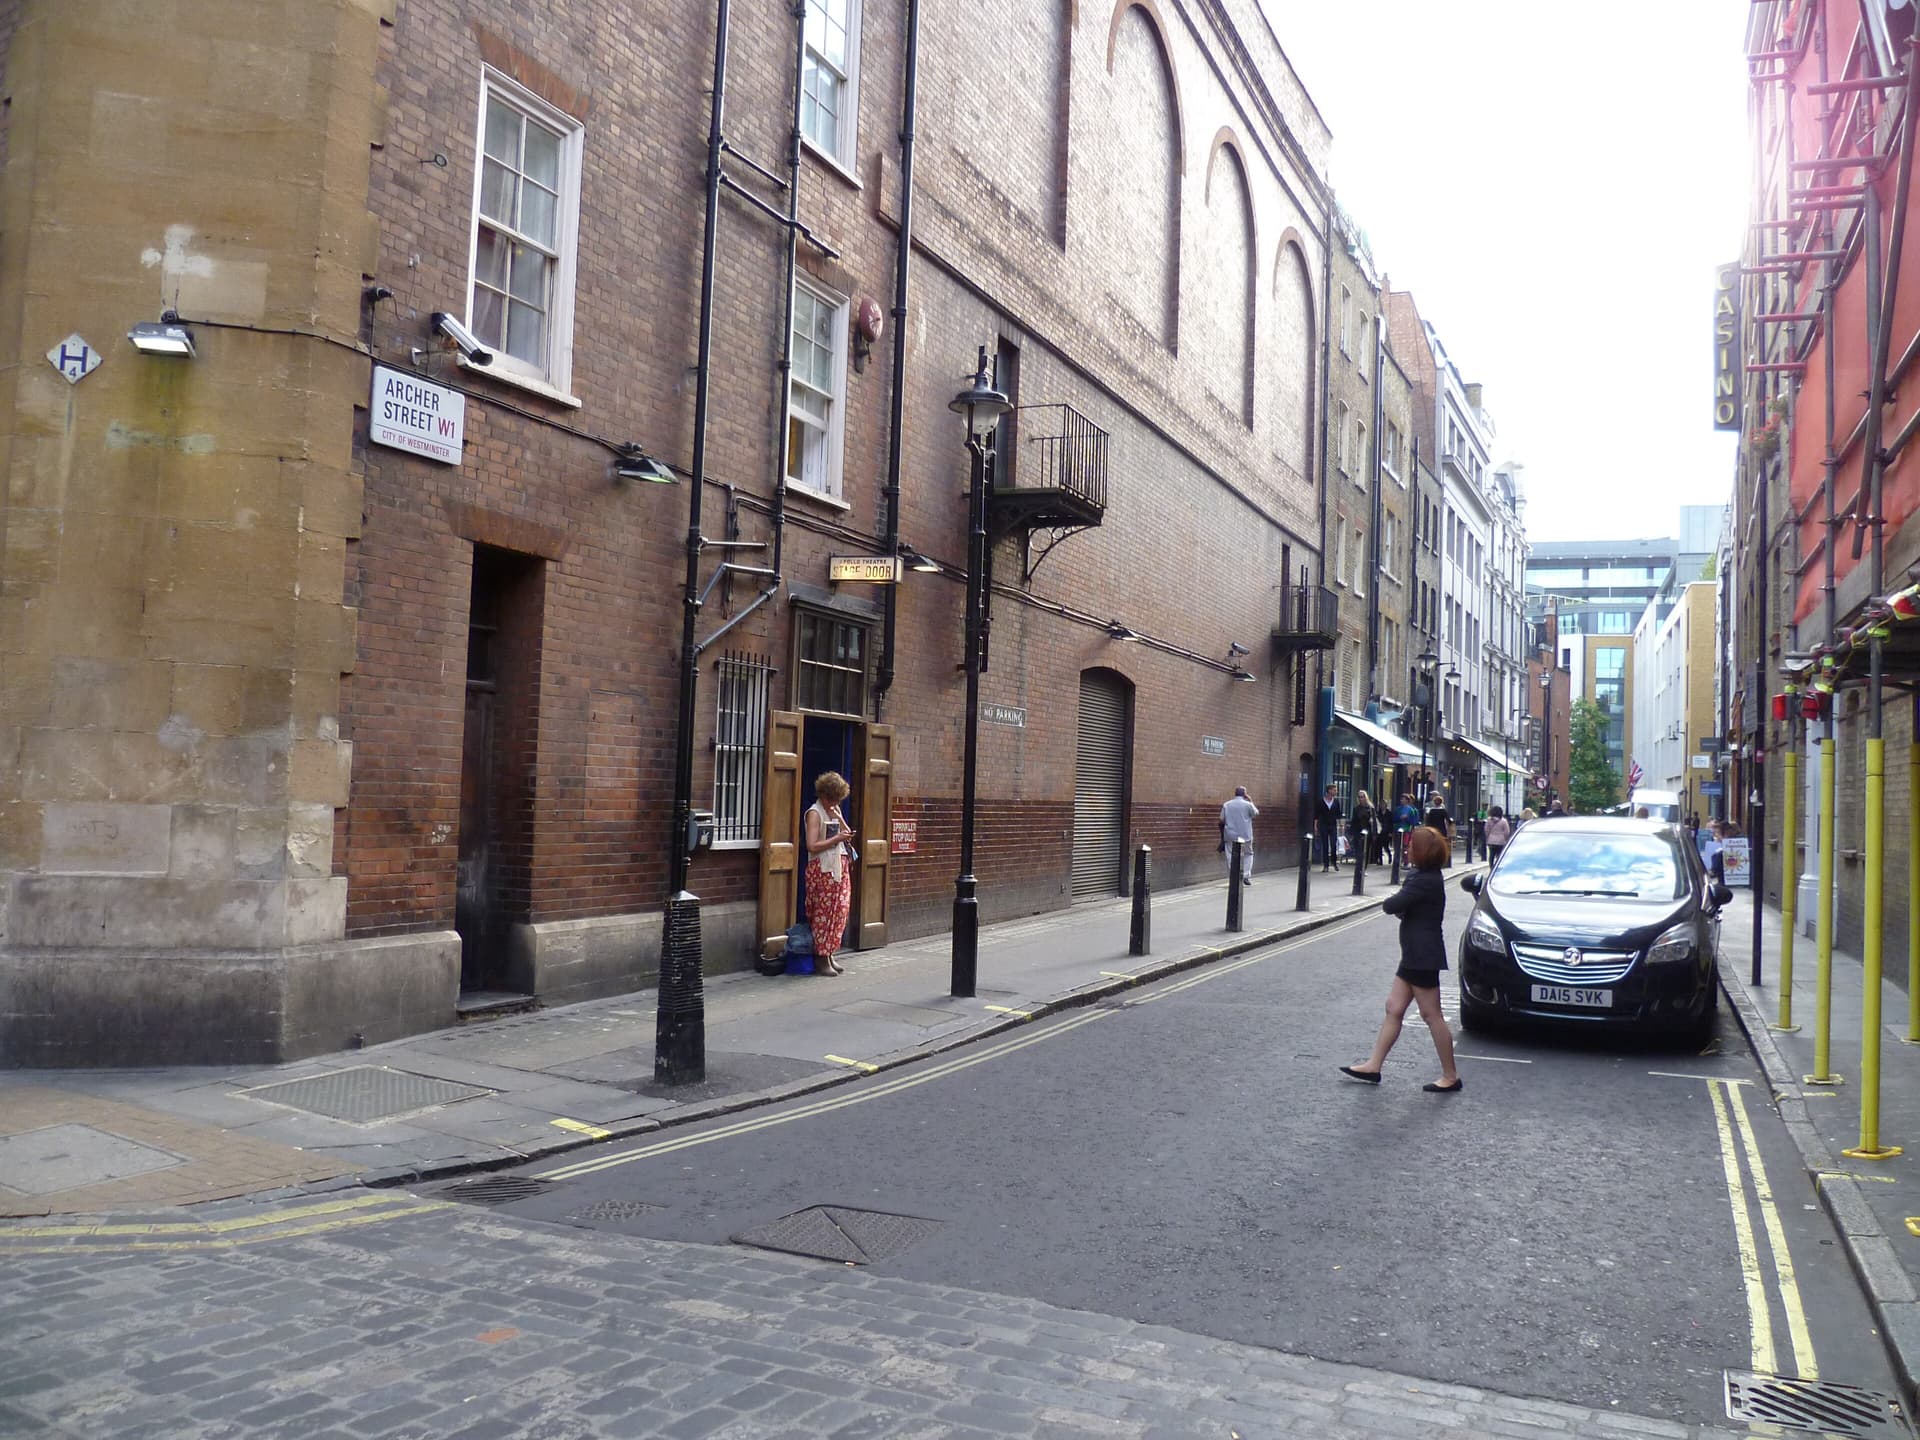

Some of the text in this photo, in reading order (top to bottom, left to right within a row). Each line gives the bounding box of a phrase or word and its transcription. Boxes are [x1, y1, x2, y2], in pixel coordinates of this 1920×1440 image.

[60, 344, 88, 373] H
[1716, 269, 1734, 424] CASINO
[69, 367, 77, 377] 4
[385, 378, 440, 412] ARCHER
[384, 401, 455, 439] STREET W1
[382, 430, 450, 457] CITY OF WESTMINSTER
[865, 565, 891, 578] DOOR
[984, 707, 1023, 723] NO PARKING
[1540, 987, 1603, 1004] DA15 SVK
